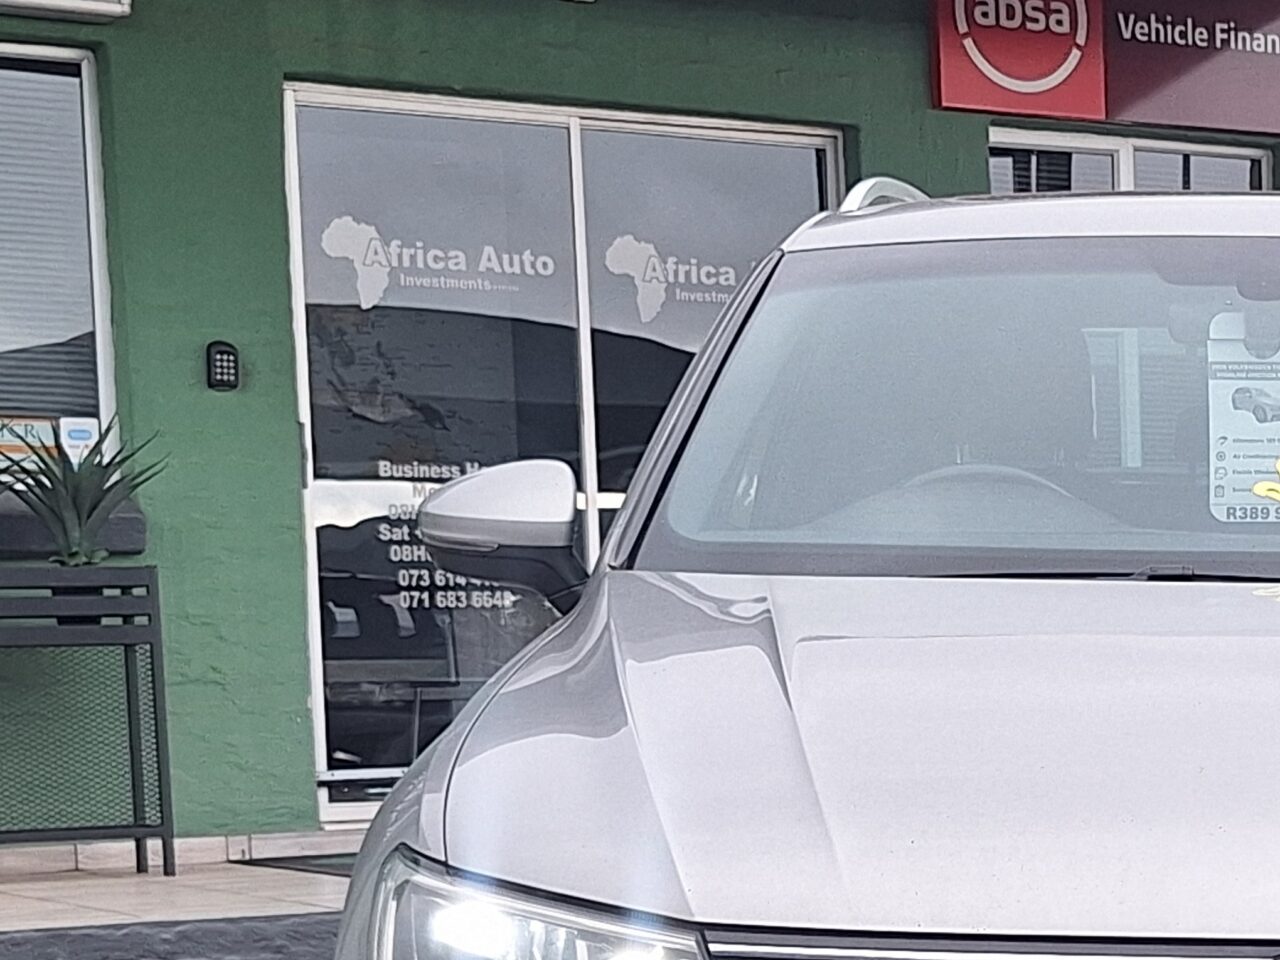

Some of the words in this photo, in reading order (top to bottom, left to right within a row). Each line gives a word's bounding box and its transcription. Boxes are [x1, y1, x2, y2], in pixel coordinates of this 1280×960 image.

[972, 0, 1072, 34] absa
[1117, 12, 1209, 48] Vehicle
[362, 237, 468, 272] Africa
[477, 244, 556, 277] Auto
[642, 256, 737, 287] Africa
[399, 272, 492, 292] Investments
[377, 460, 462, 479] Business
[1226, 506, 1271, 520] R389
[377, 523, 411, 542] Sat
[398, 569, 431, 587] 073
[400, 590, 431, 609] 071
[435, 590, 468, 609] 683
